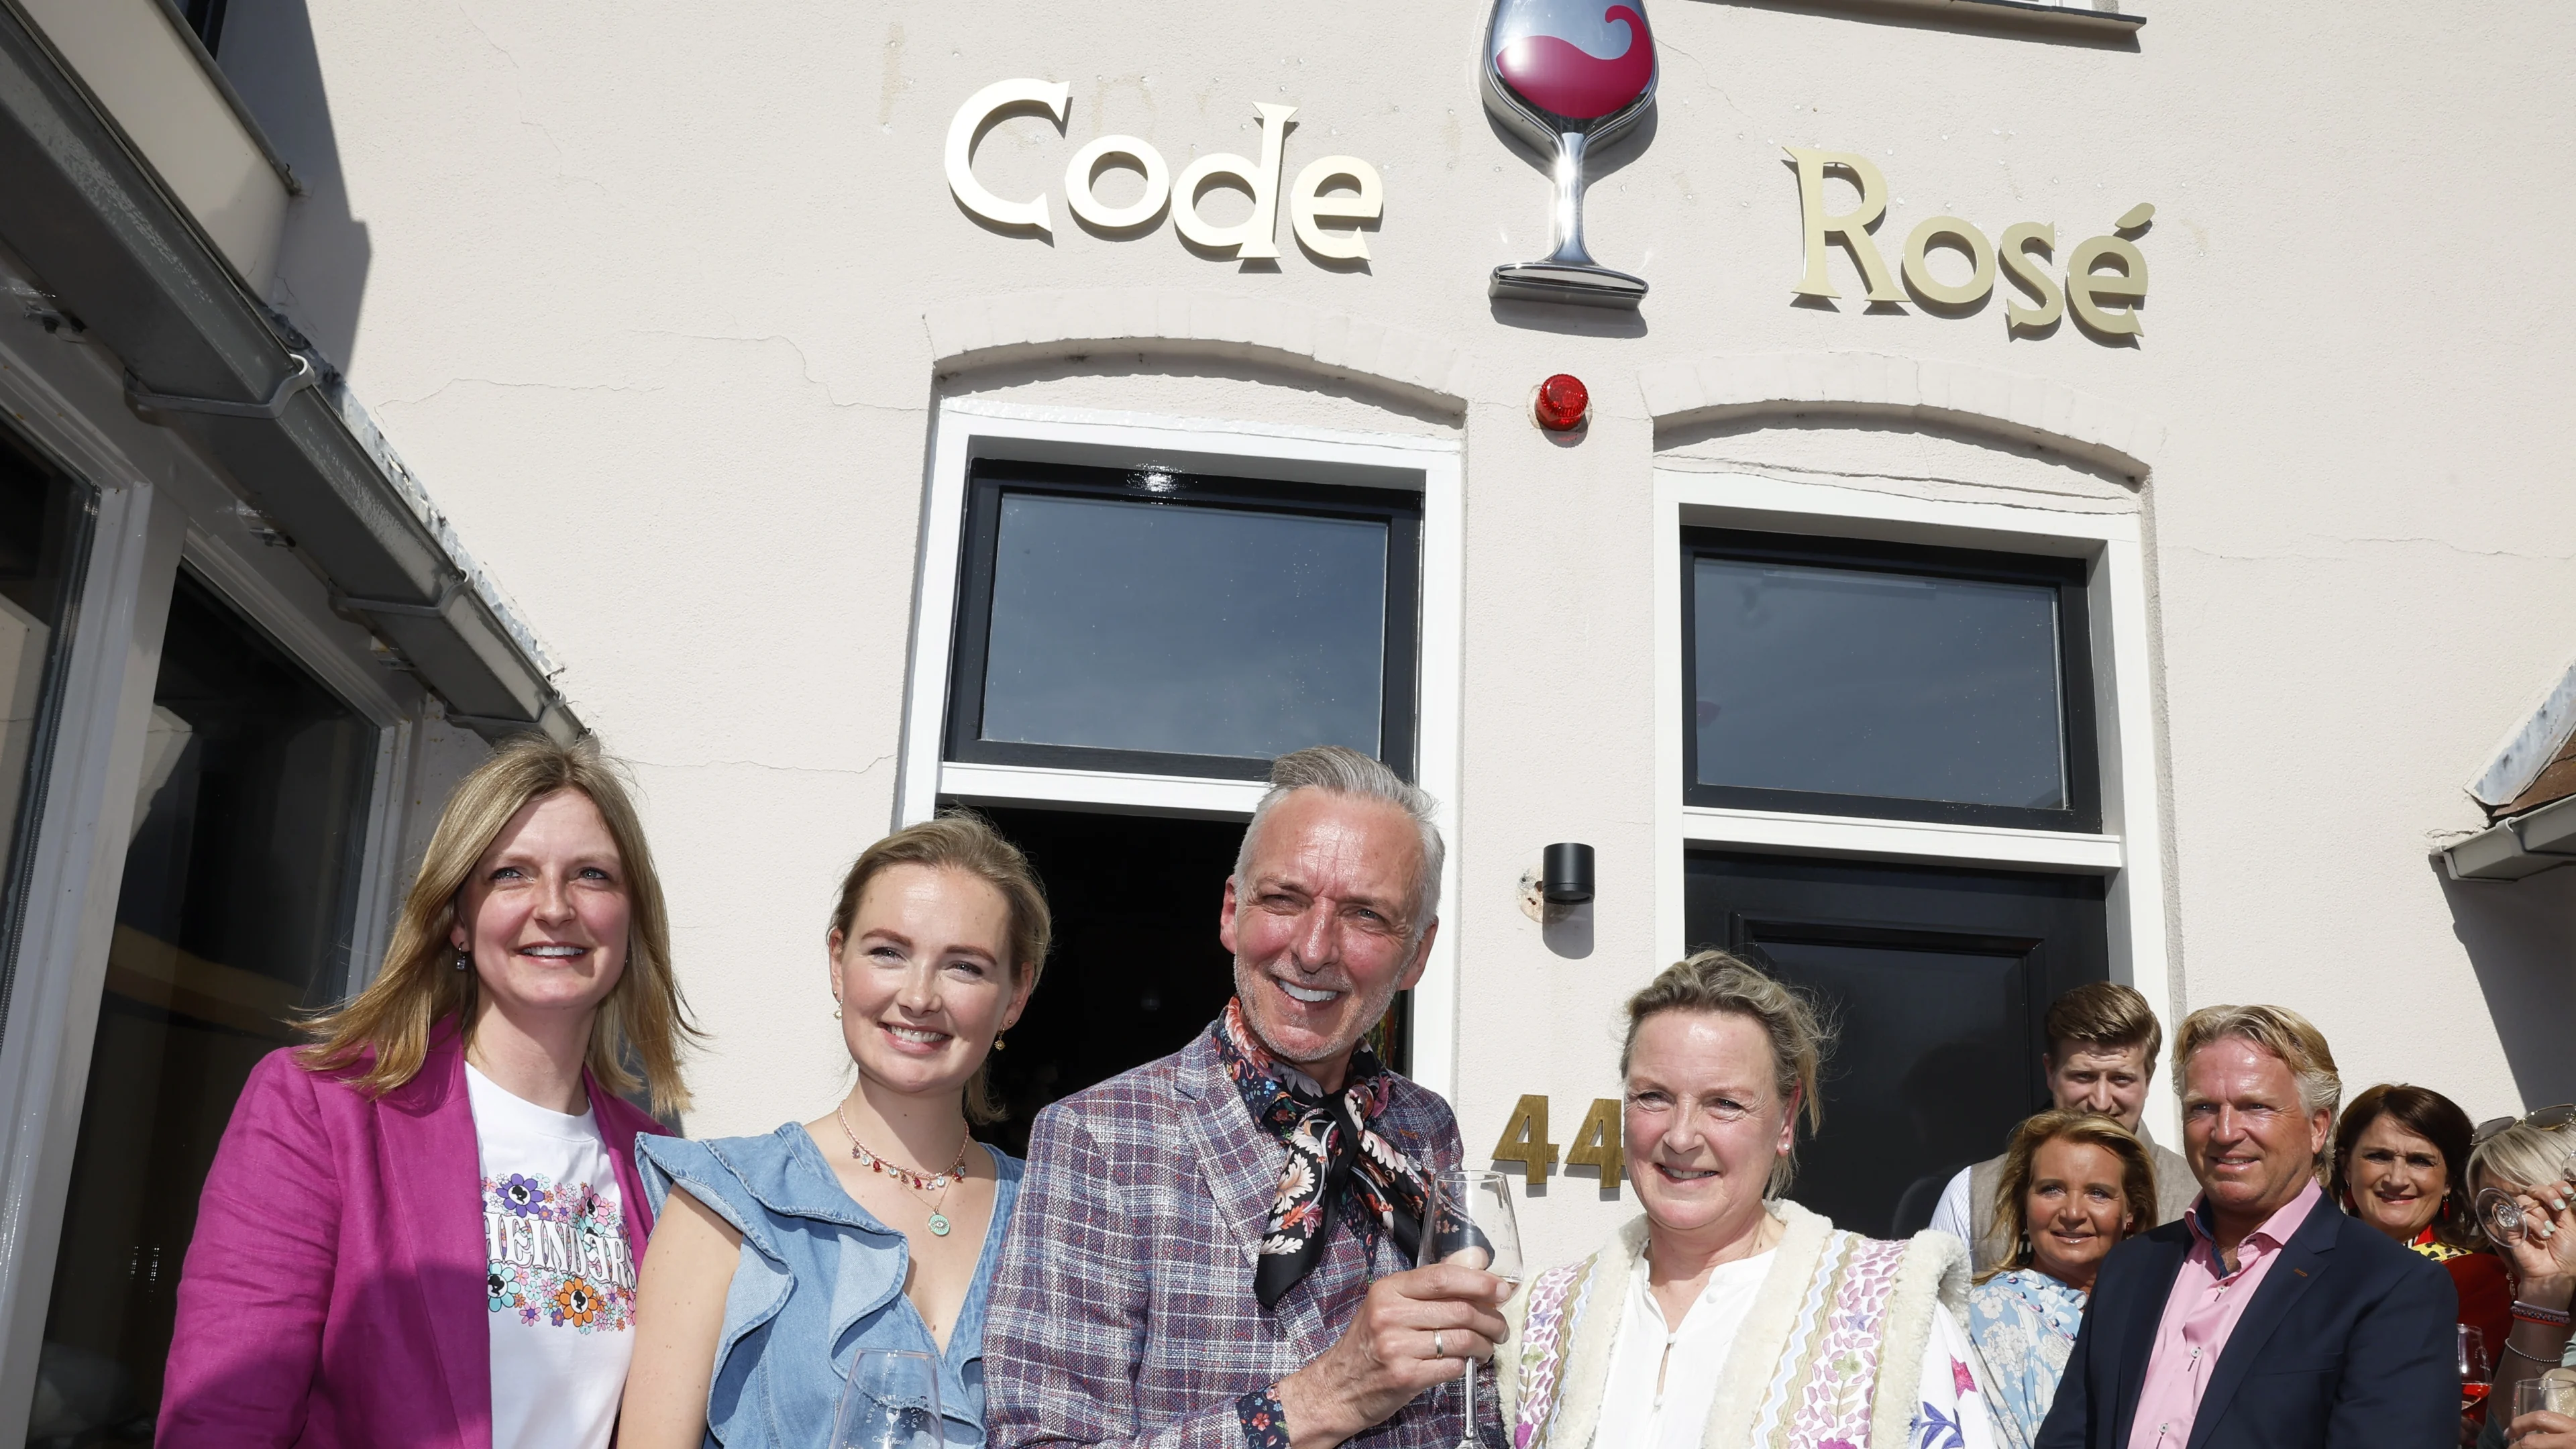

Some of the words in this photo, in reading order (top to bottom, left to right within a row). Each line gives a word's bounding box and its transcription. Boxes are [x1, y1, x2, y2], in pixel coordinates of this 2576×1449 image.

[945, 78, 1383, 262] Code
[1781, 146, 2155, 337] Rosé
[1491, 1094, 1625, 1188] 44
[872, 1436, 889, 1444] Cod
